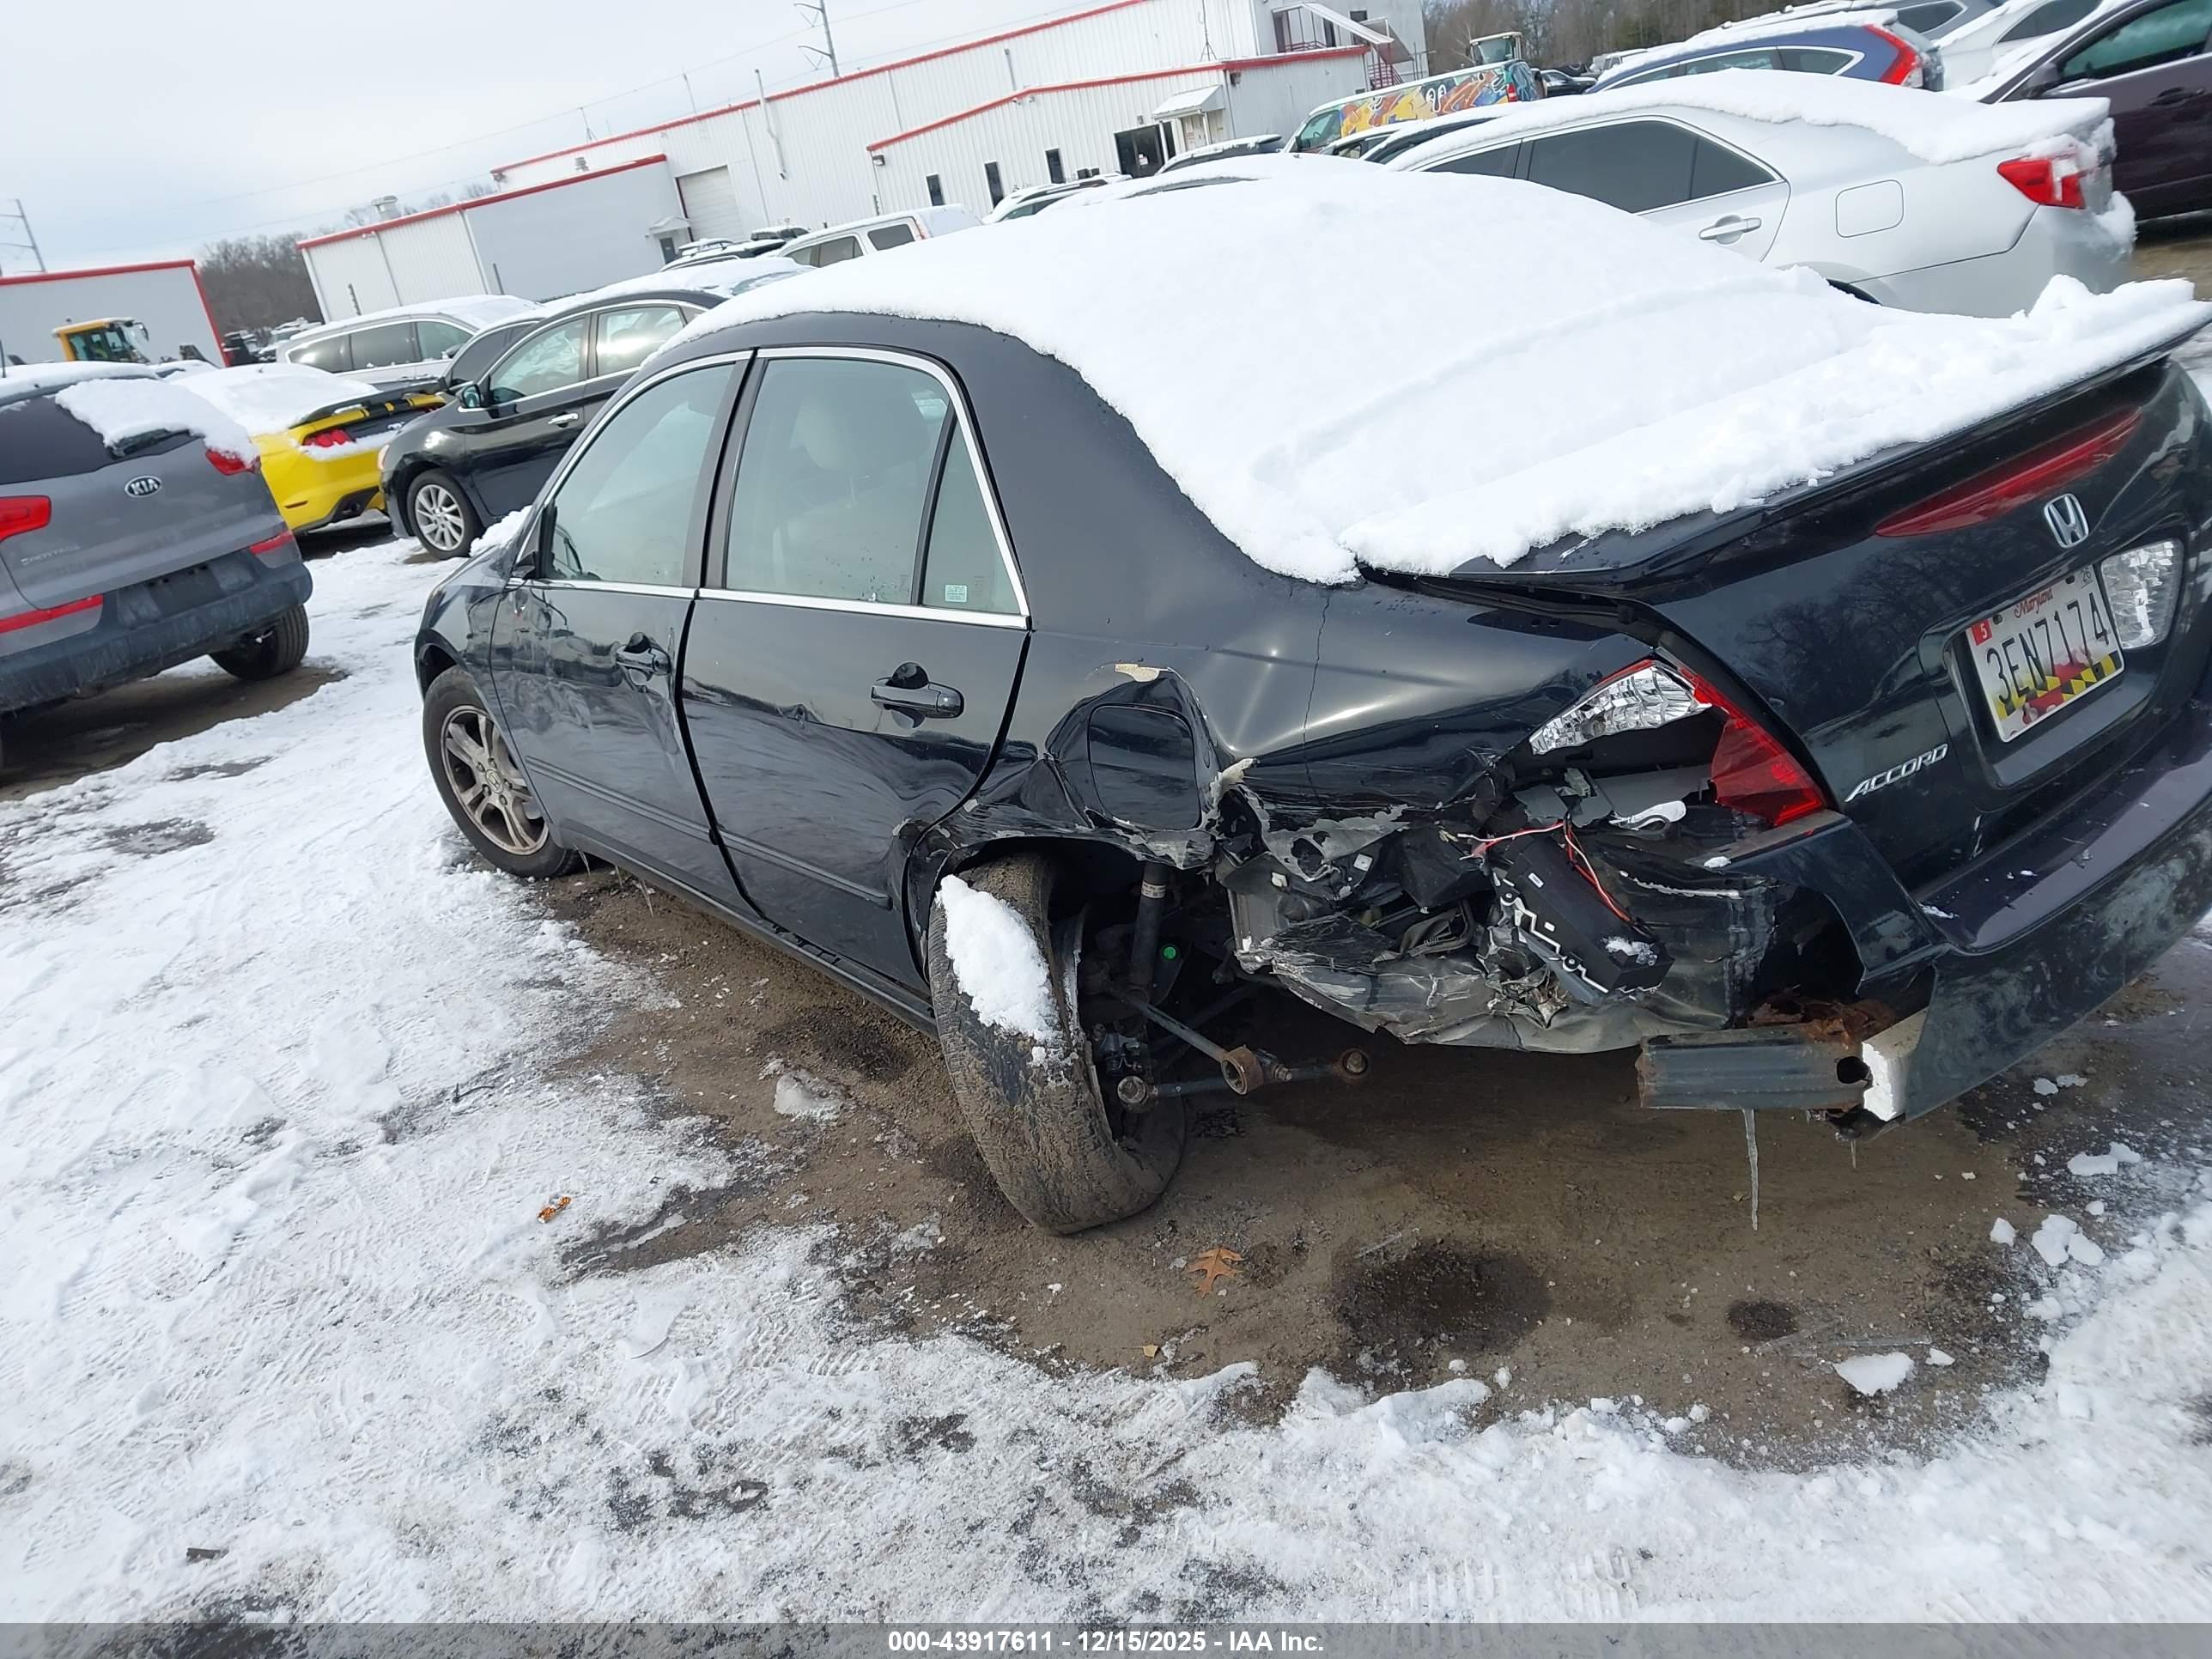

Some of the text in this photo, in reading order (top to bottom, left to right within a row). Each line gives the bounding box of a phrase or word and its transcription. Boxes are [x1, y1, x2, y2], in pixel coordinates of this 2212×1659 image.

[129, 477, 159, 495] KIA
[2013, 587, 2054, 618] Maryland
[1979, 623, 1988, 639] 5
[1986, 592, 2110, 705] 3EN7174
[1844, 743, 1948, 803] ACCORD
